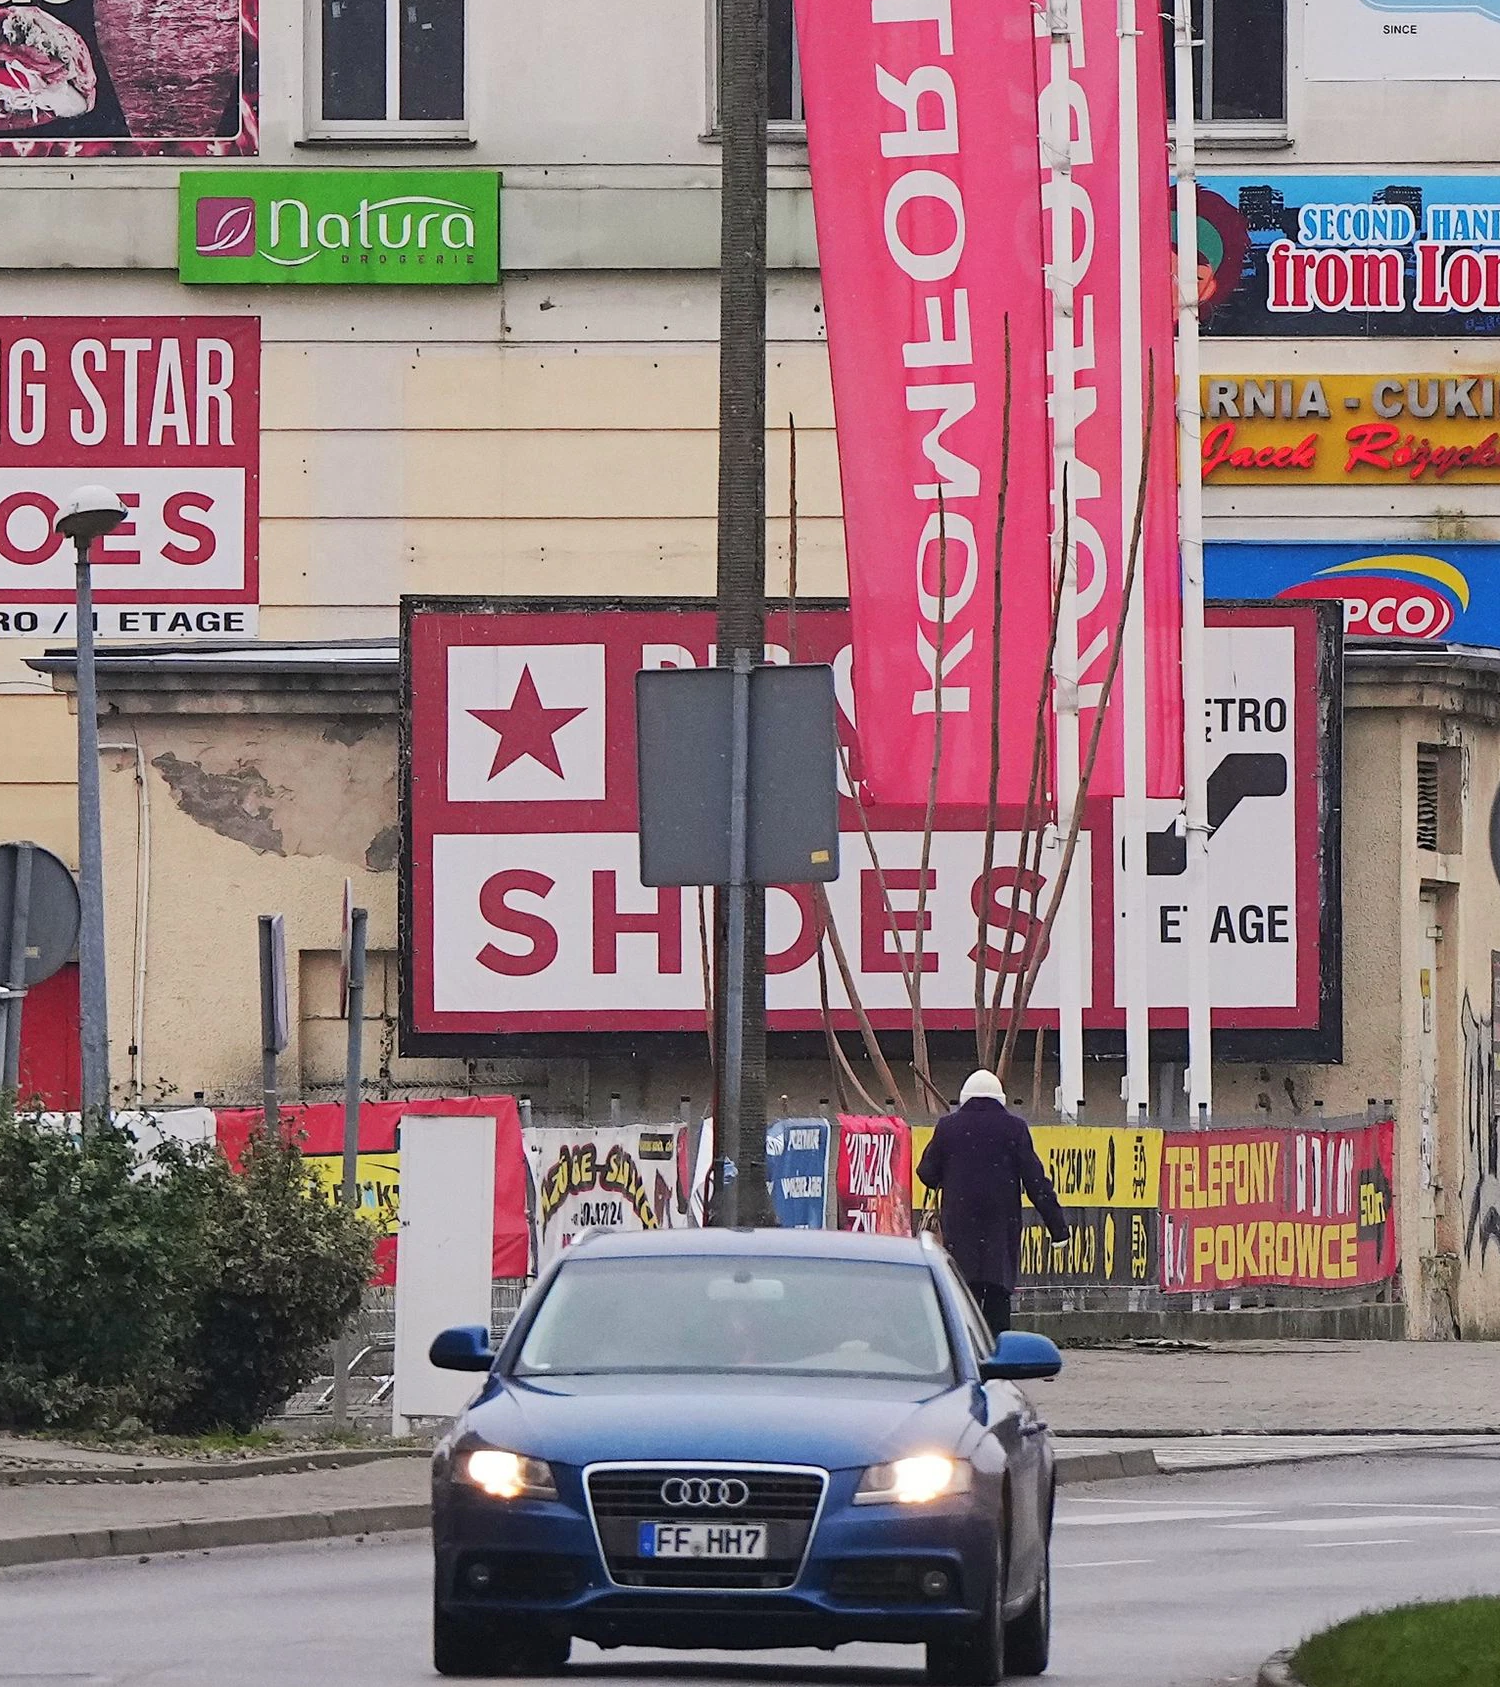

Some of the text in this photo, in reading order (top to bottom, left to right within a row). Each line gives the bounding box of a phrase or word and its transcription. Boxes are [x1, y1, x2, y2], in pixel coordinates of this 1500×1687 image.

[1382, 23, 1418, 35] SINCE
[1301, 206, 1414, 243] SECOND
[340, 253, 476, 266] DROGERIE
[1270, 244, 1402, 310] from
[69, 337, 236, 447] STAR
[1200, 379, 1331, 418] RNIA
[1201, 420, 1319, 479] Jacek
[119, 612, 245, 632] ETAGE
[1343, 596, 1436, 637] PCO
[1159, 904, 1290, 944] EAGE
[1165, 1141, 1279, 1209] TELEFONY
[1193, 1220, 1358, 1283] POKROWCE
[657, 1527, 761, 1554] FF HH7
